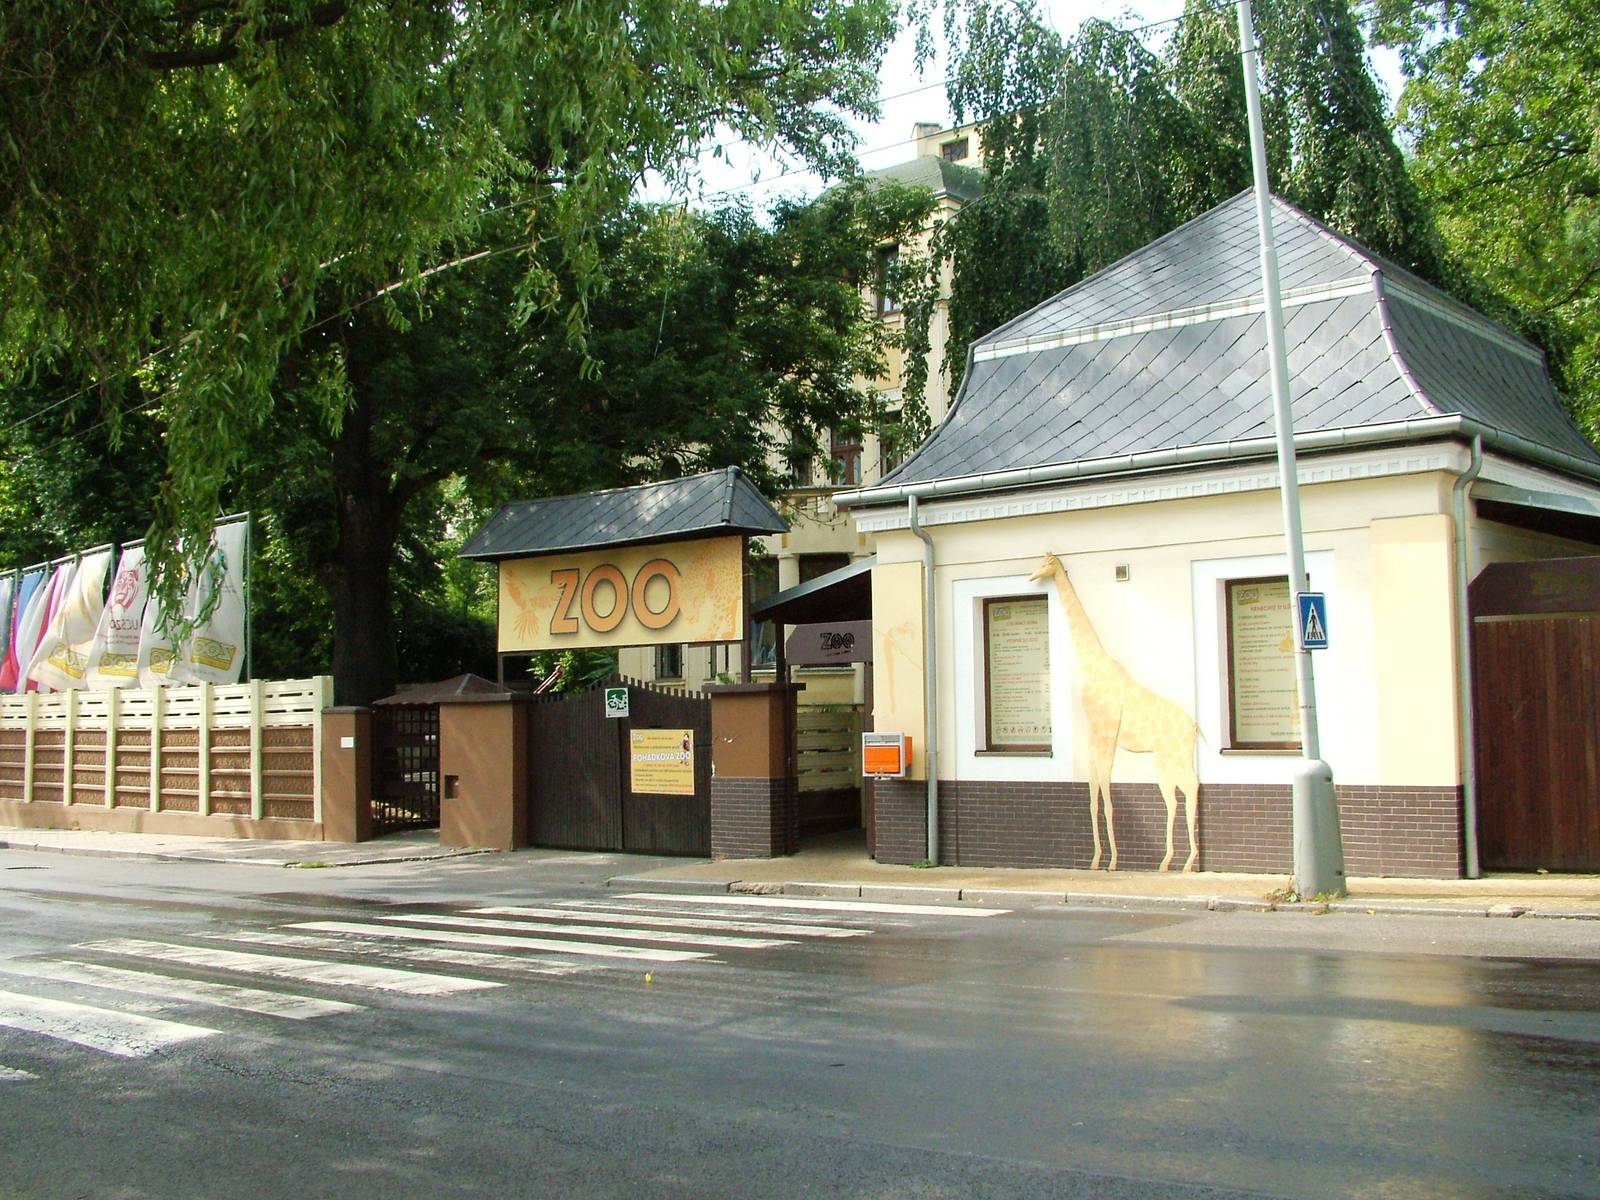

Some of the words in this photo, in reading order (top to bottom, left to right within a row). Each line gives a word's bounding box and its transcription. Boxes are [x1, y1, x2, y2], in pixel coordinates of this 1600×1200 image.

[550, 558, 681, 635] ZOO
[820, 632, 855, 649] ZOO
[676, 751, 691, 760] ZOO
